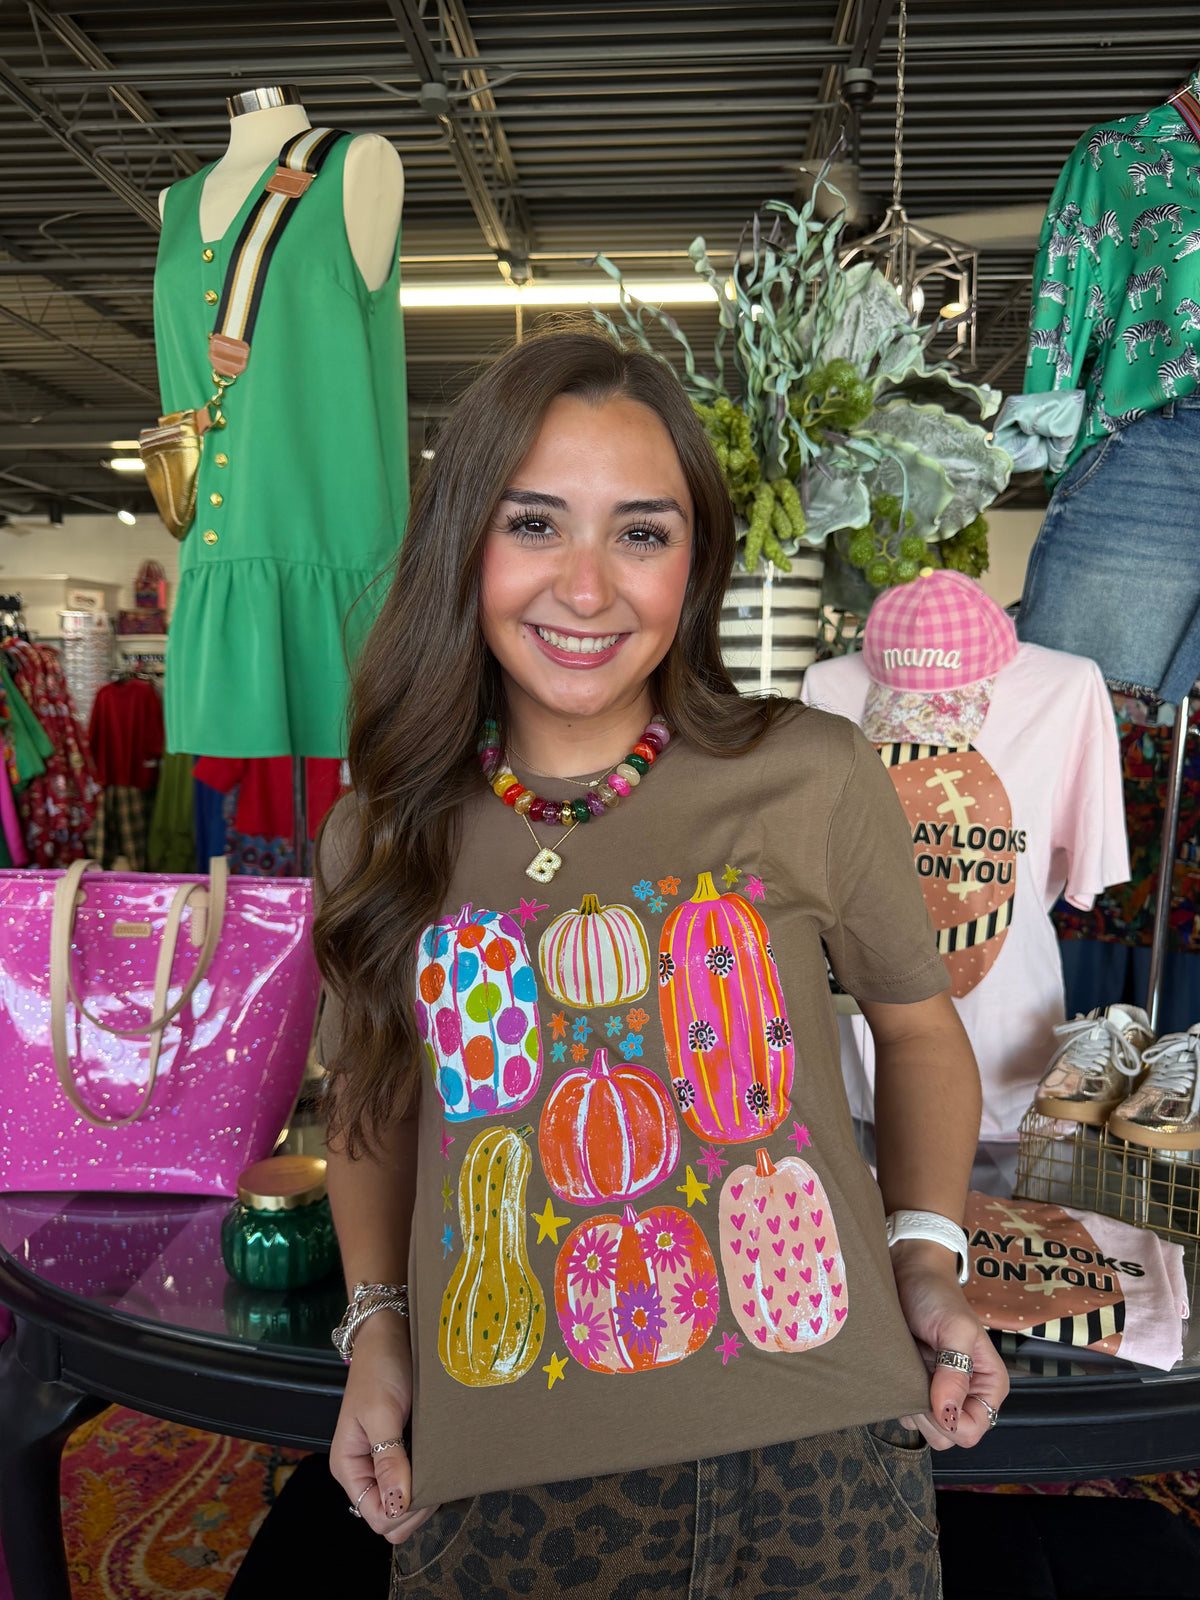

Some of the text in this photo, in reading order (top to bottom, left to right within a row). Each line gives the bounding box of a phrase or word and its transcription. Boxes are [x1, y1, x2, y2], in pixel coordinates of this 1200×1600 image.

[883, 648, 961, 670] mama
[913, 822, 1027, 853] AY LOOKS
[525, 848, 562, 883] B
[916, 854, 1013, 885] ON YOU
[1024, 1237, 1145, 1278] LOOKS
[976, 1257, 1113, 1293] ON YOU
